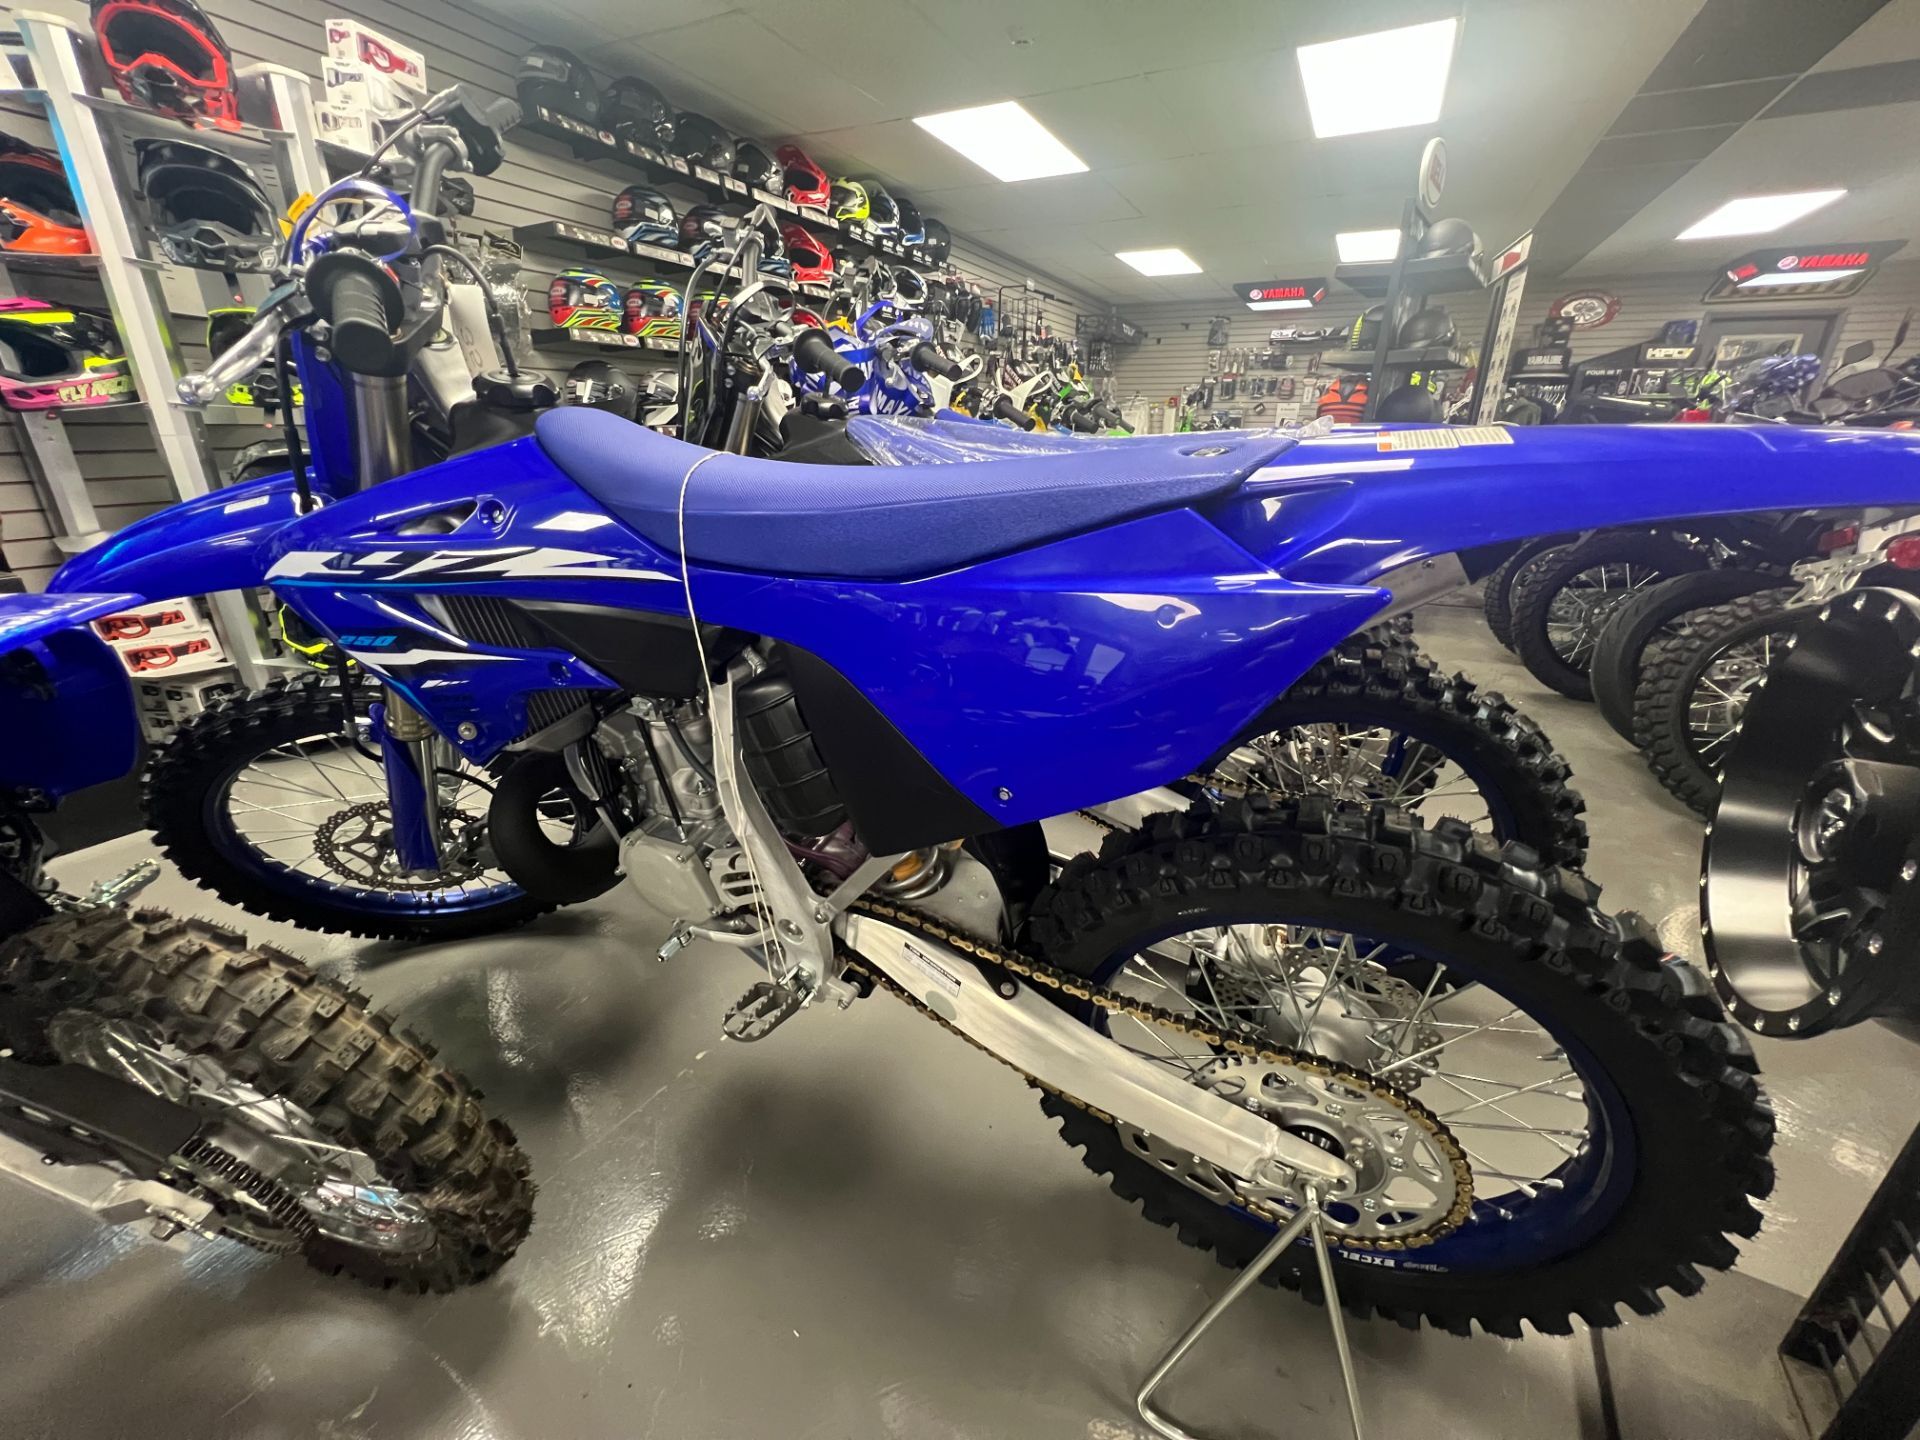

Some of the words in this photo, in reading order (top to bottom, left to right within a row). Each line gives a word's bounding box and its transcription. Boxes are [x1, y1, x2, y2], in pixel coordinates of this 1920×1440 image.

[1799, 252, 1870, 268] YAMAHA
[1262, 287, 1306, 299] YAMAHA
[58, 382, 89, 402] FLY
[338, 635, 398, 647] 250
[1338, 1249, 1396, 1268] EXCEL
